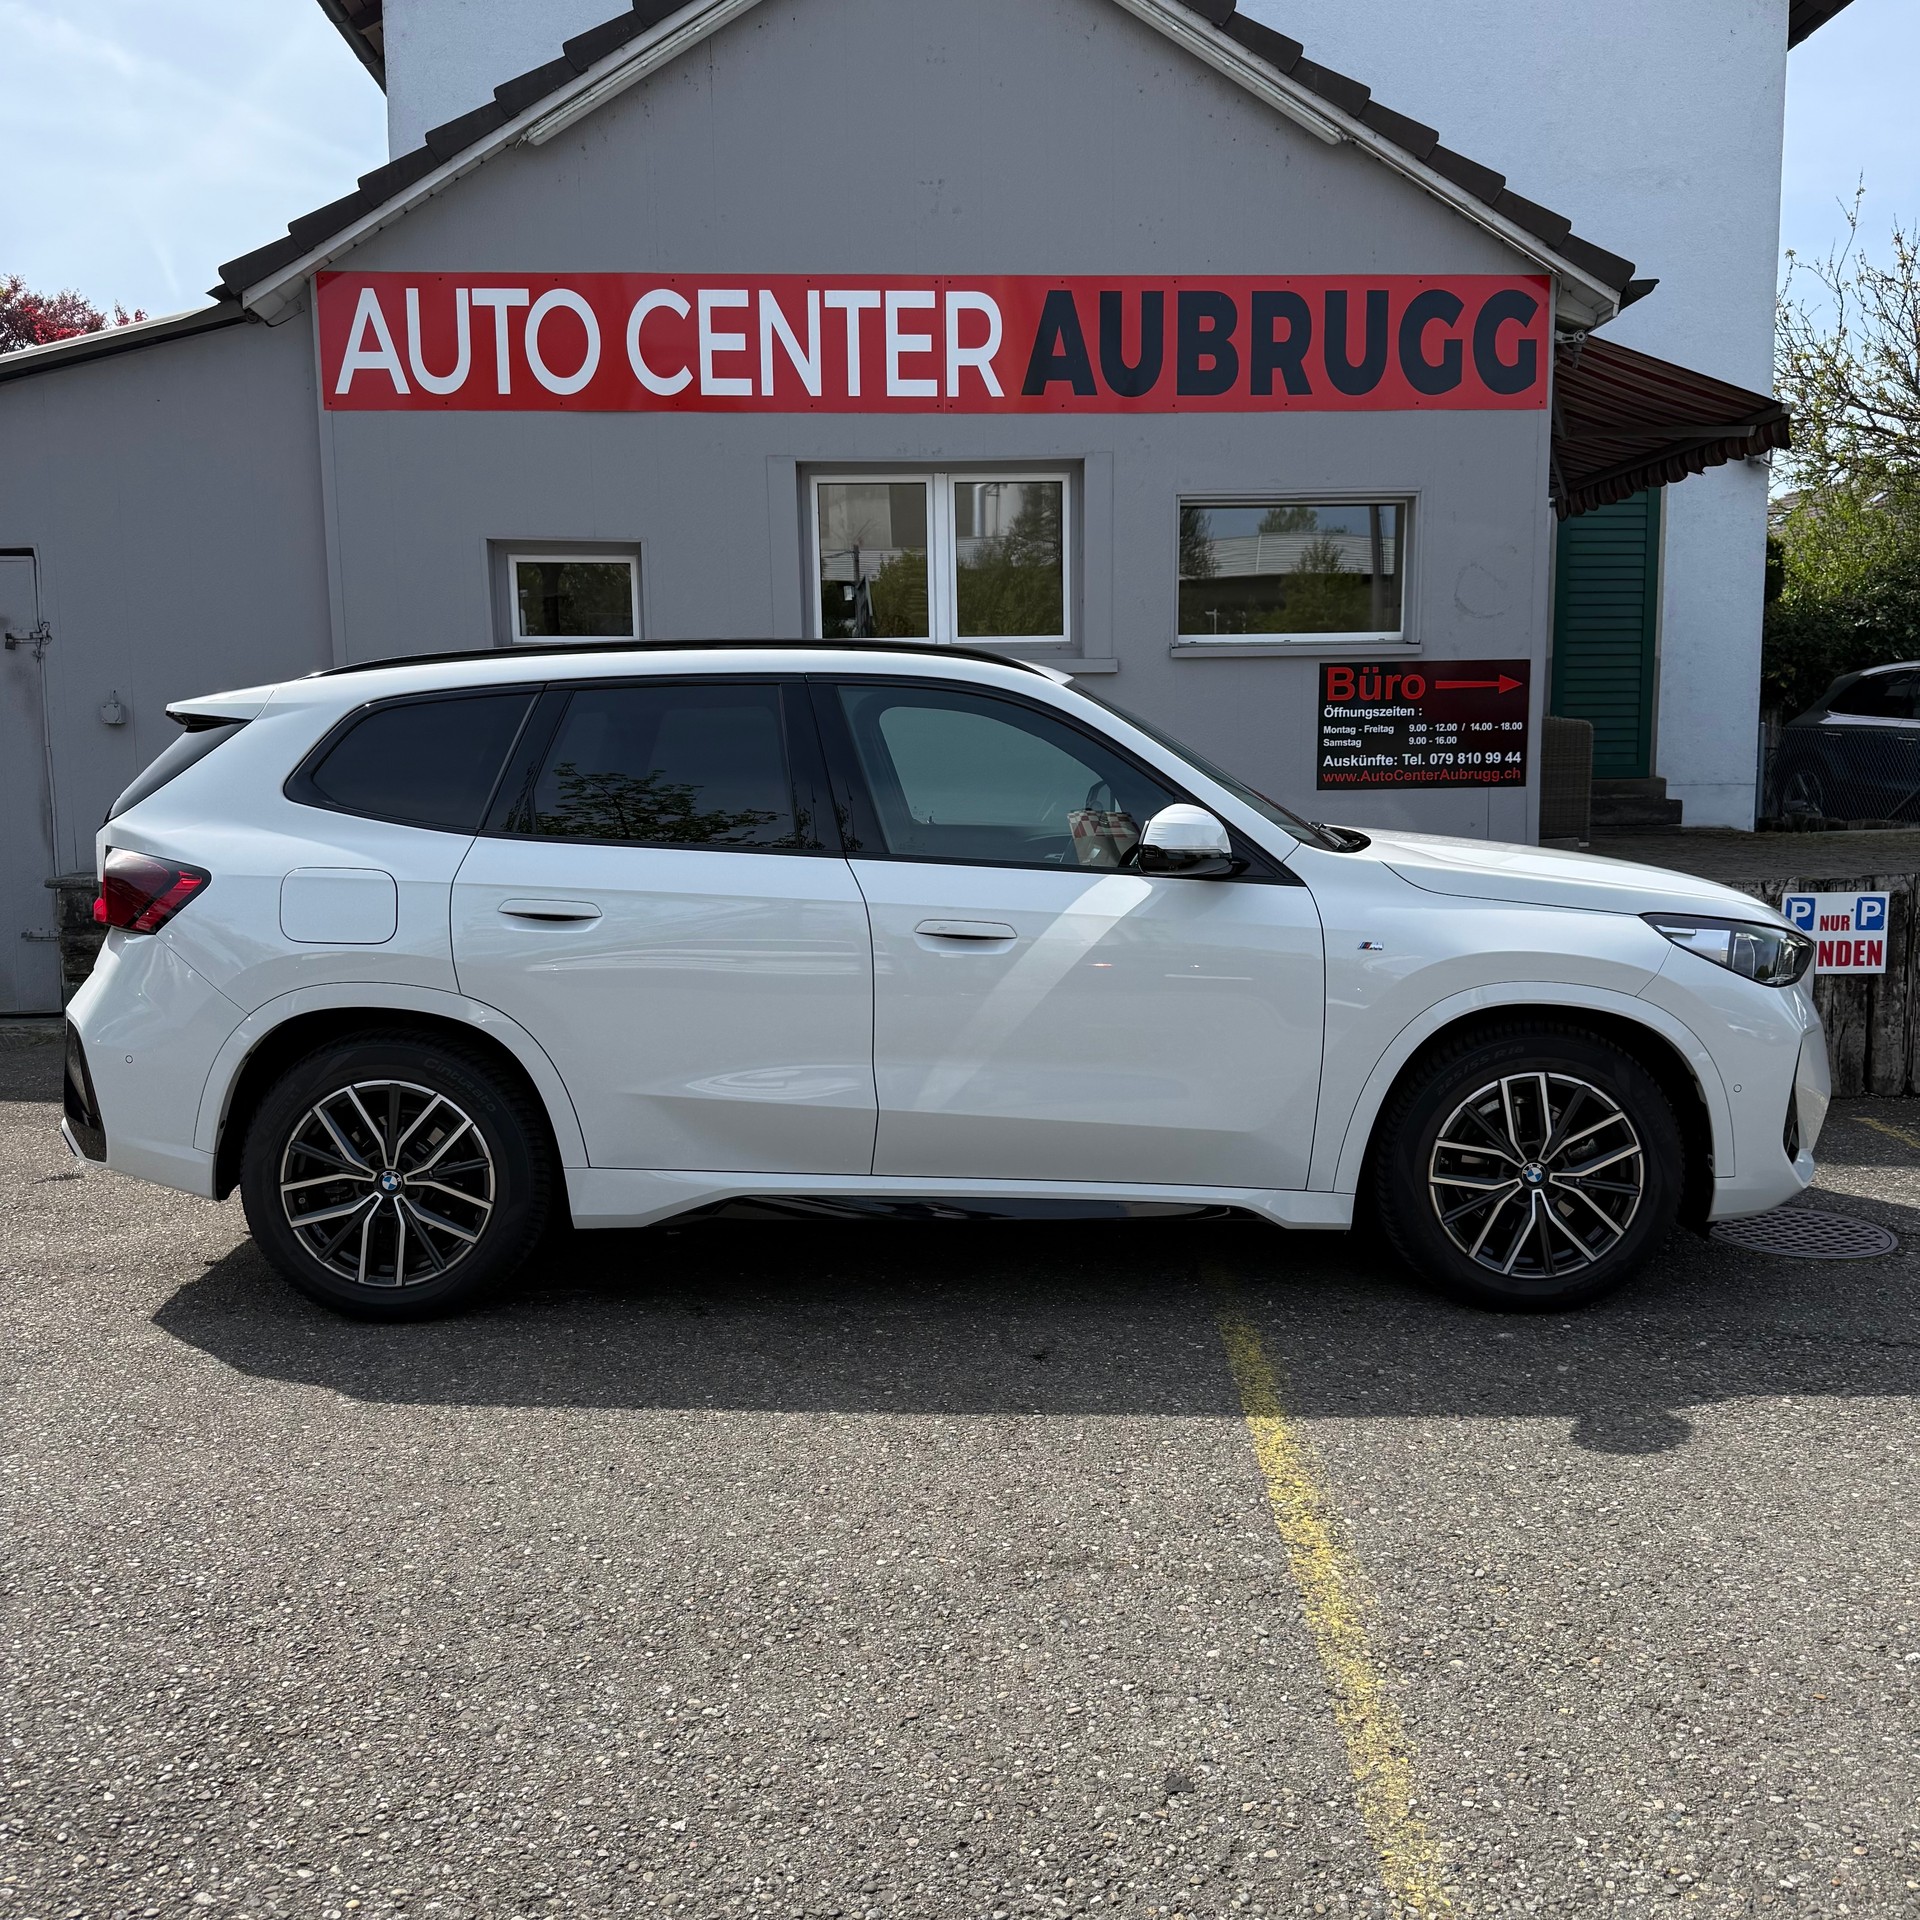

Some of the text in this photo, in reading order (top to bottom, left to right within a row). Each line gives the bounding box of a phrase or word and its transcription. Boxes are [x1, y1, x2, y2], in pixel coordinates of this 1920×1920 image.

[334, 288, 1539, 398] AUTO CENTER AUBRUGG
[1327, 667, 1426, 700] Büro
[1324, 705, 1415, 719] Öffnungszeiten
[1323, 726, 1356, 735] Montag
[1364, 725, 1394, 734] Freitag
[1408, 724, 1427, 733] 9.00
[1435, 723, 1458, 732] 12.00
[1470, 722, 1493, 732] 14.00
[1500, 722, 1523, 731] 18.00
[1323, 738, 1362, 748] Samstag
[1408, 737, 1427, 745] 9.00
[1435, 736, 1457, 745] 16.00
[1323, 752, 1521, 767] Auskünfte: Tel. 079 810 99 44
[1323, 767, 1521, 782] www.AutoCenterAubrugg.ch
[1819, 915, 1851, 932] NUR
[1816, 940, 1883, 967] NDEN
